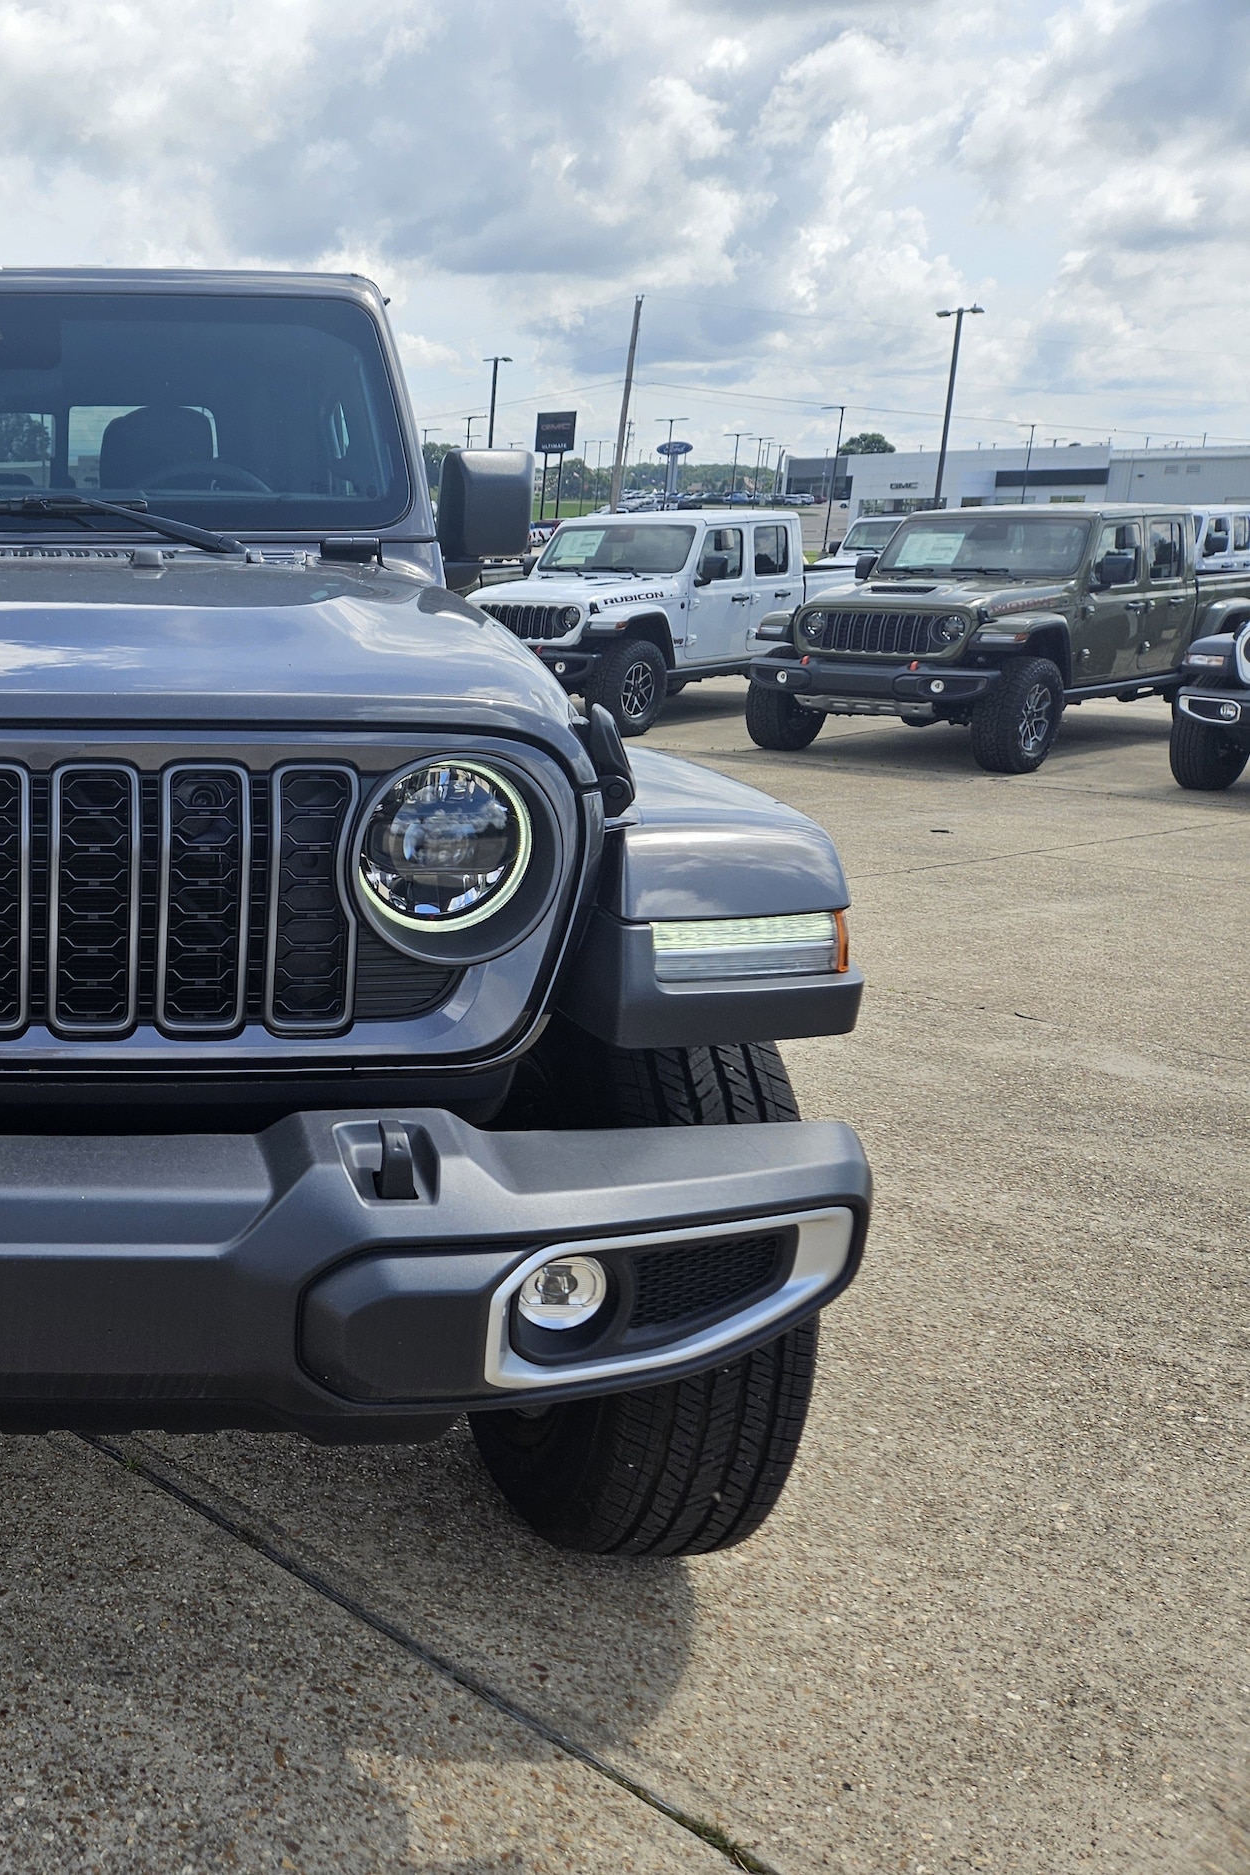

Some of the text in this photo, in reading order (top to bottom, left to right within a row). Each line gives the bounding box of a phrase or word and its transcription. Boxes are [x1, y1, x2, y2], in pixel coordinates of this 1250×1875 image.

[540, 422, 571, 431] GMC
[889, 481, 919, 490] GMC
[603, 591, 665, 605] RUBICON
